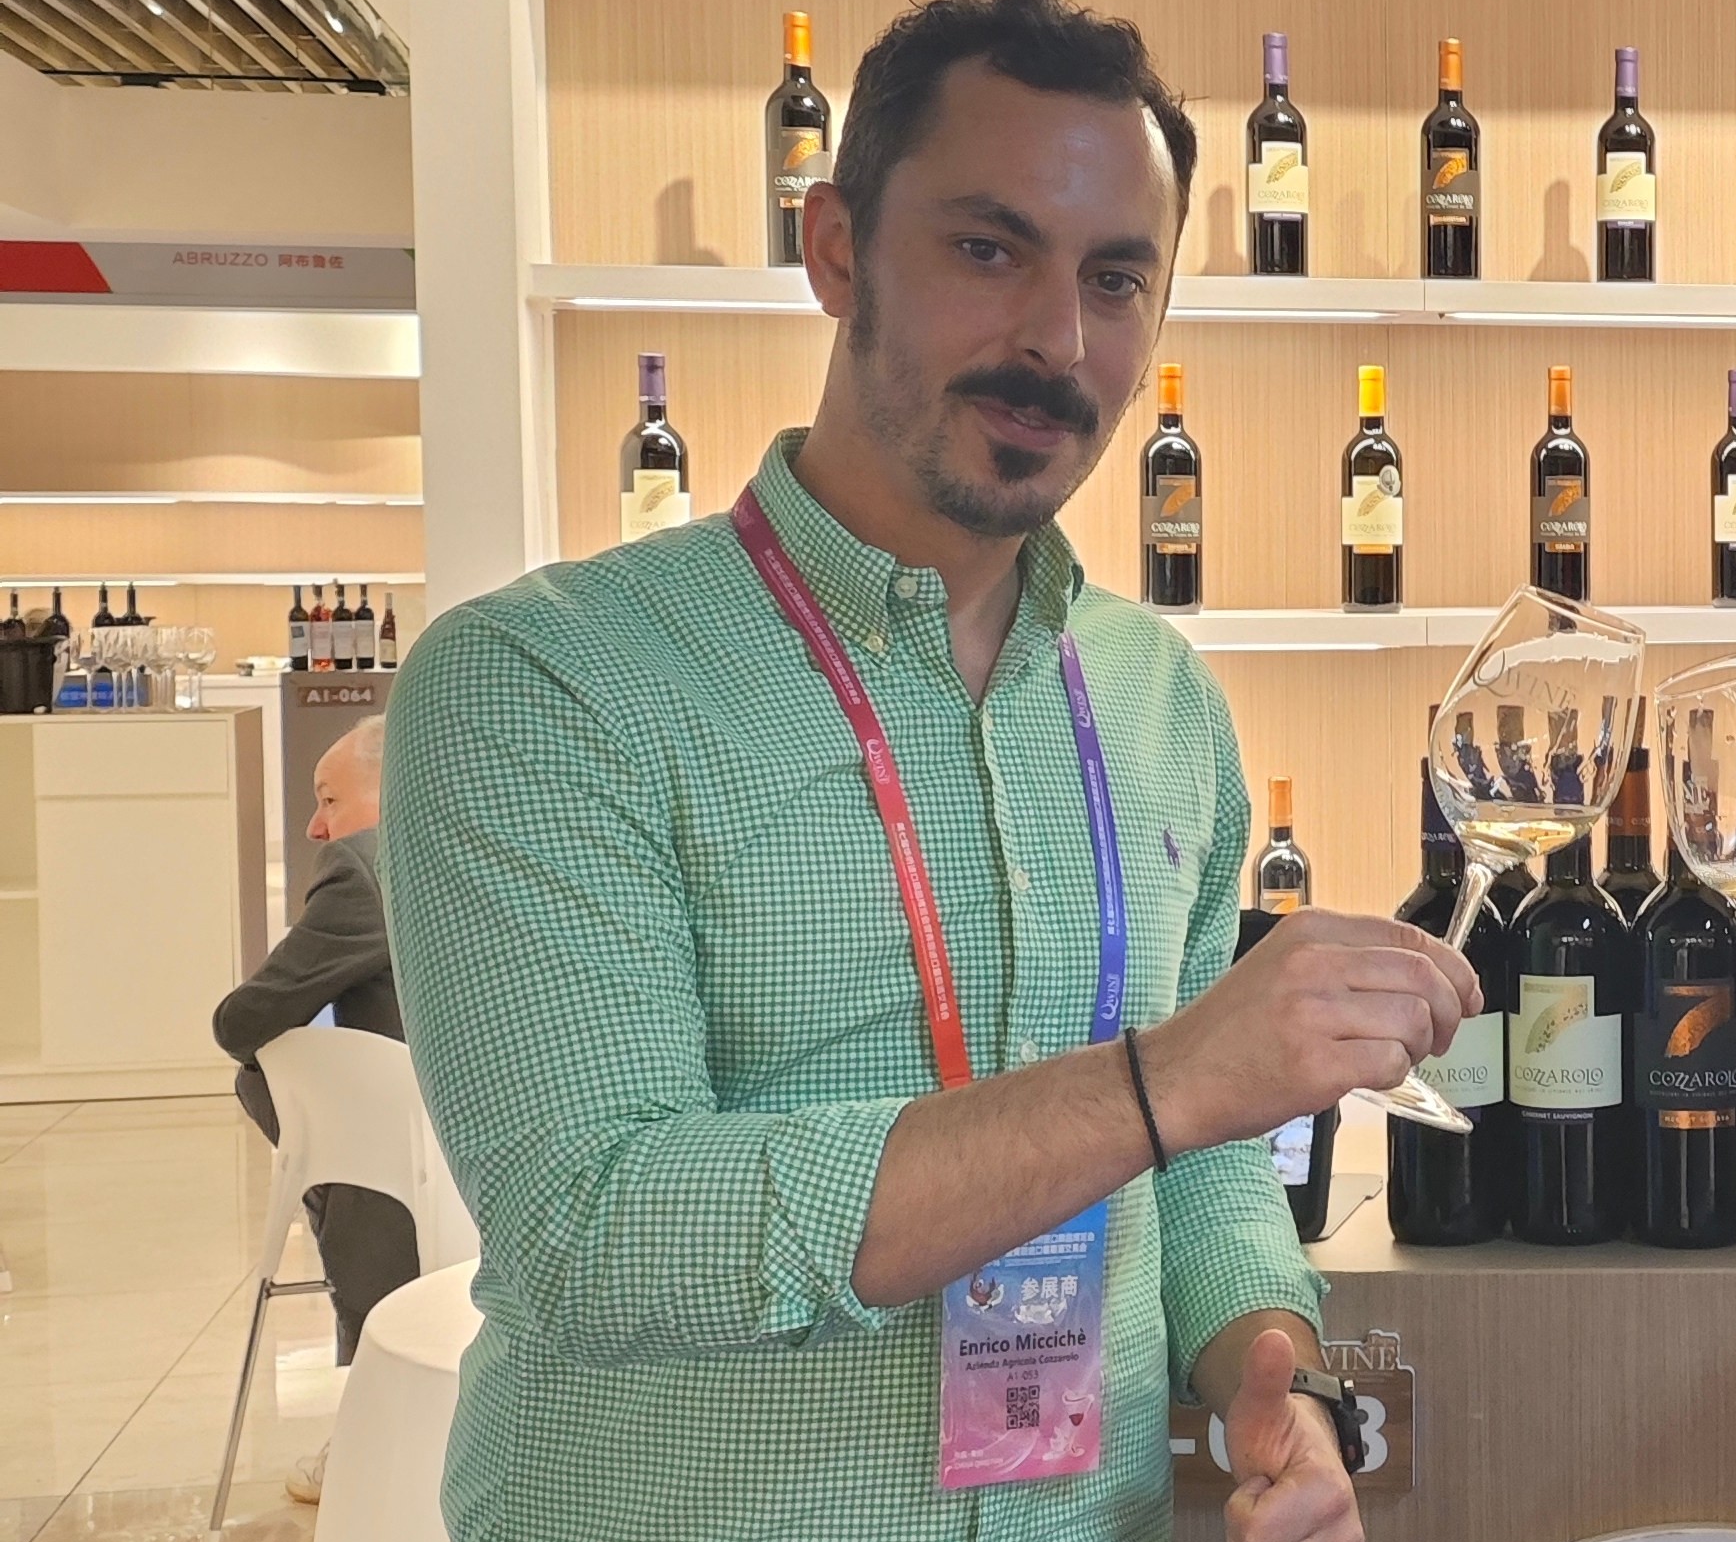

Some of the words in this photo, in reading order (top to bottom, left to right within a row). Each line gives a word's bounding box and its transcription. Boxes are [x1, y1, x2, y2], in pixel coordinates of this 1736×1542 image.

[172, 250, 269, 268] ABRUZZO
[277, 253, 345, 270] 阿布鲁佐
[306, 688, 372, 703] A1-064
[1514, 1065, 1604, 1088] COZZAROLO
[1020, 1274, 1079, 1302] 参展商
[959, 1337, 1010, 1357] Enrico
[1016, 1328, 1087, 1351] Miccichè
[965, 1360, 1000, 1372] Azienda
[1002, 1356, 1037, 1370] Agricola
[1038, 1352, 1080, 1365] Cozzarolo
